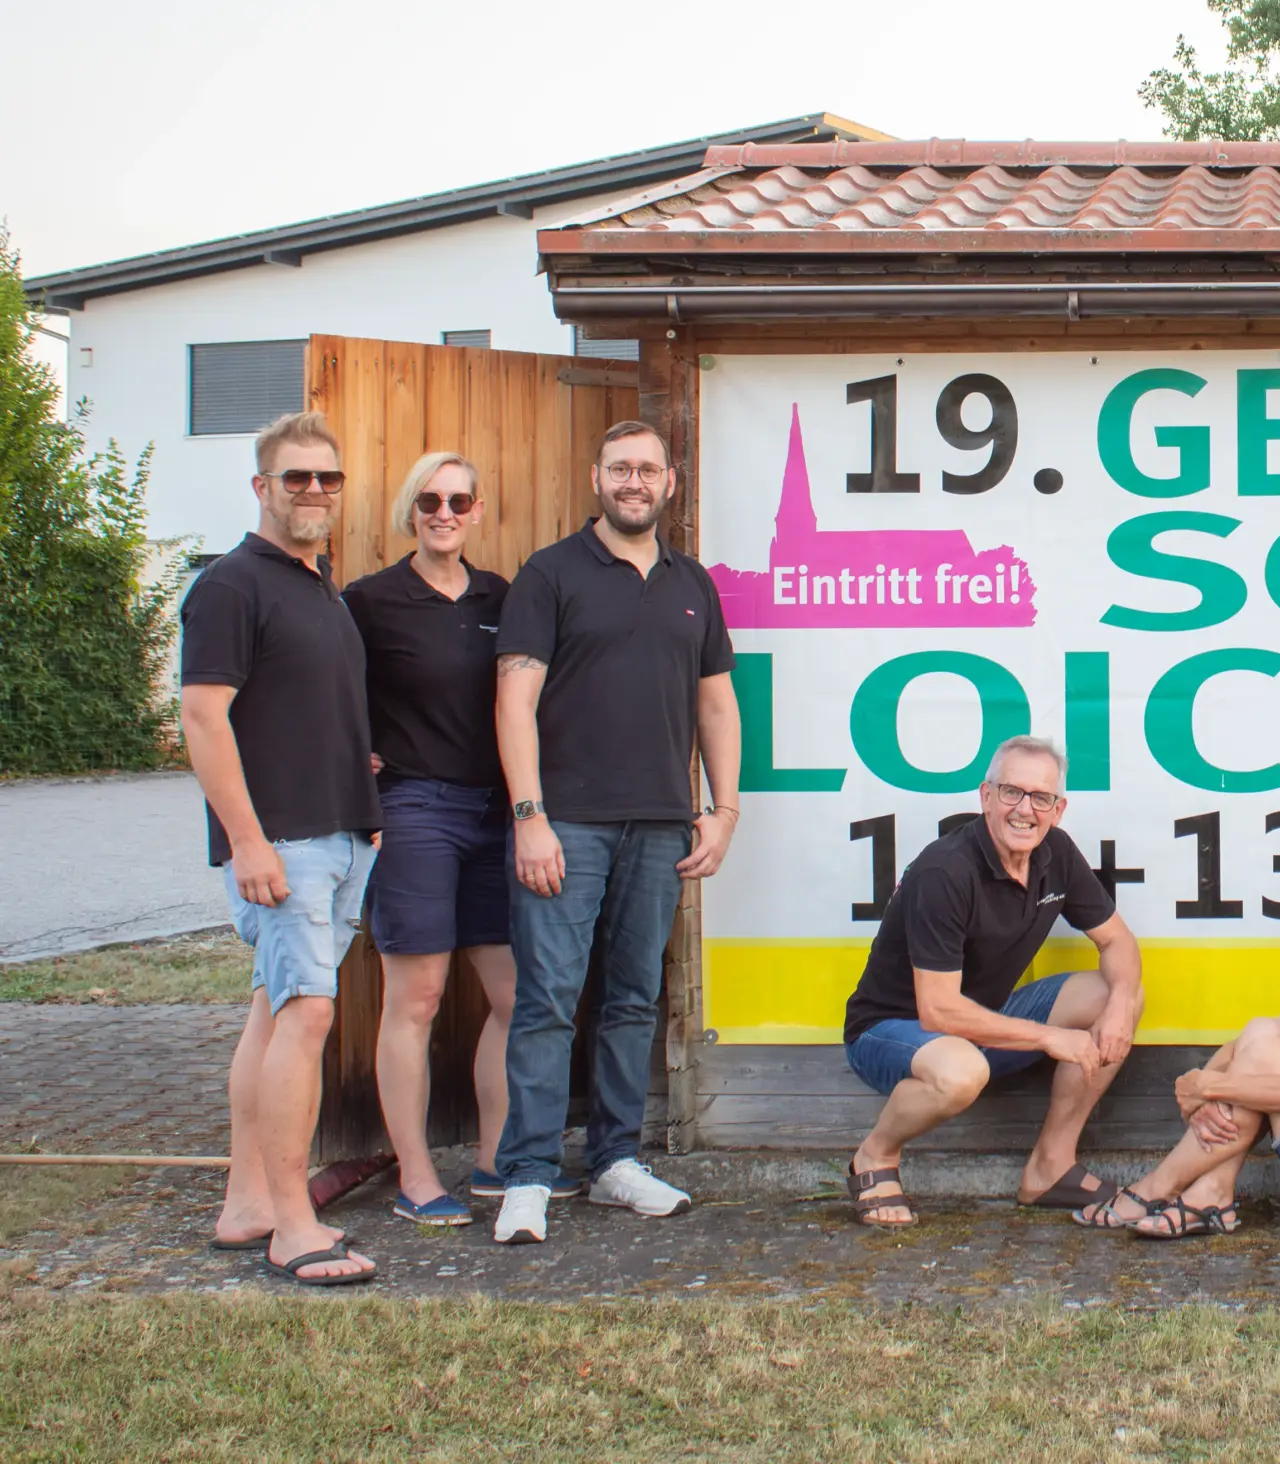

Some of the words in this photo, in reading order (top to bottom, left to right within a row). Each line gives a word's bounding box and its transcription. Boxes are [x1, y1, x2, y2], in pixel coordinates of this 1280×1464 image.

[845, 372, 1064, 495] 19.
[773, 563, 923, 605] Eintritt
[934, 562, 1021, 605] frei!
[850, 812, 983, 922] 1
